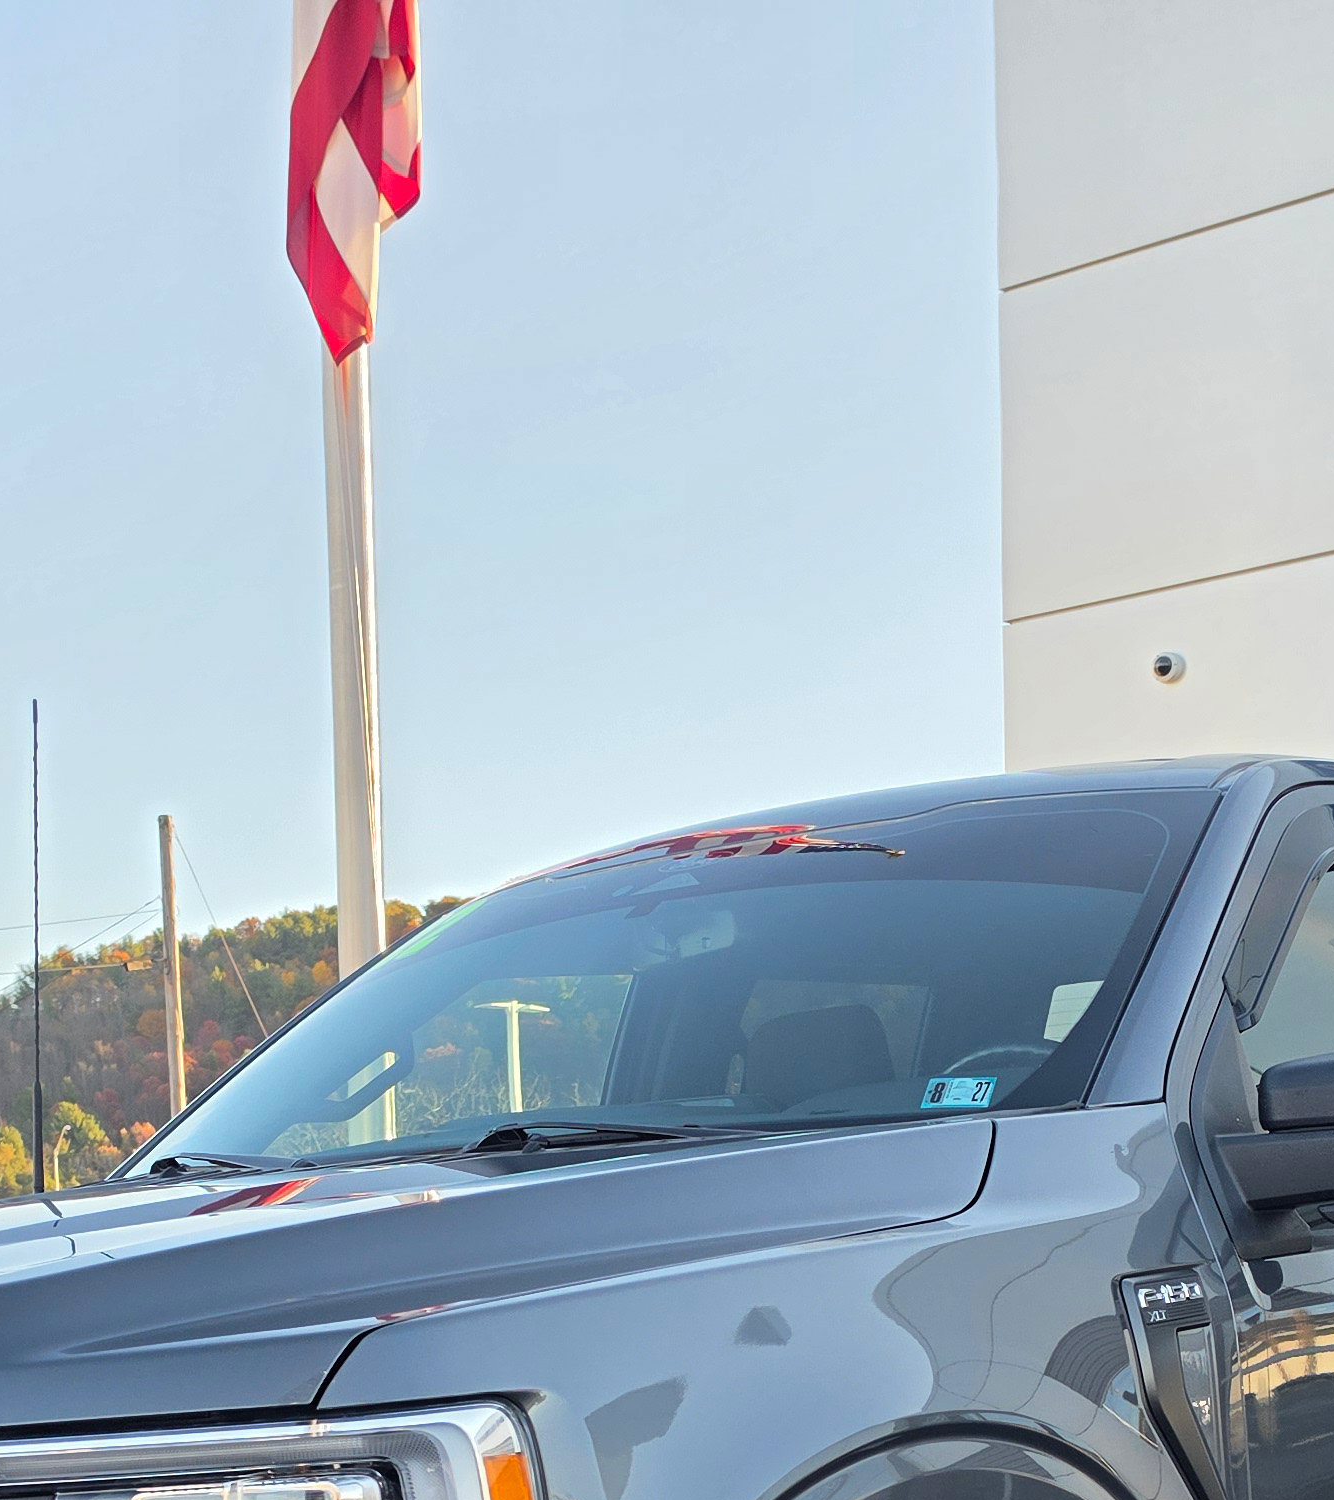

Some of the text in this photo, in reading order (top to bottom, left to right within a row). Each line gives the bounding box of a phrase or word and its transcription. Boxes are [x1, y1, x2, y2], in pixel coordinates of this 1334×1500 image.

[929, 1082, 946, 1104] 8
[971, 1081, 992, 1103] 27
[1137, 1282, 1203, 1308] F-150
[1148, 1310, 1167, 1323] XLT
